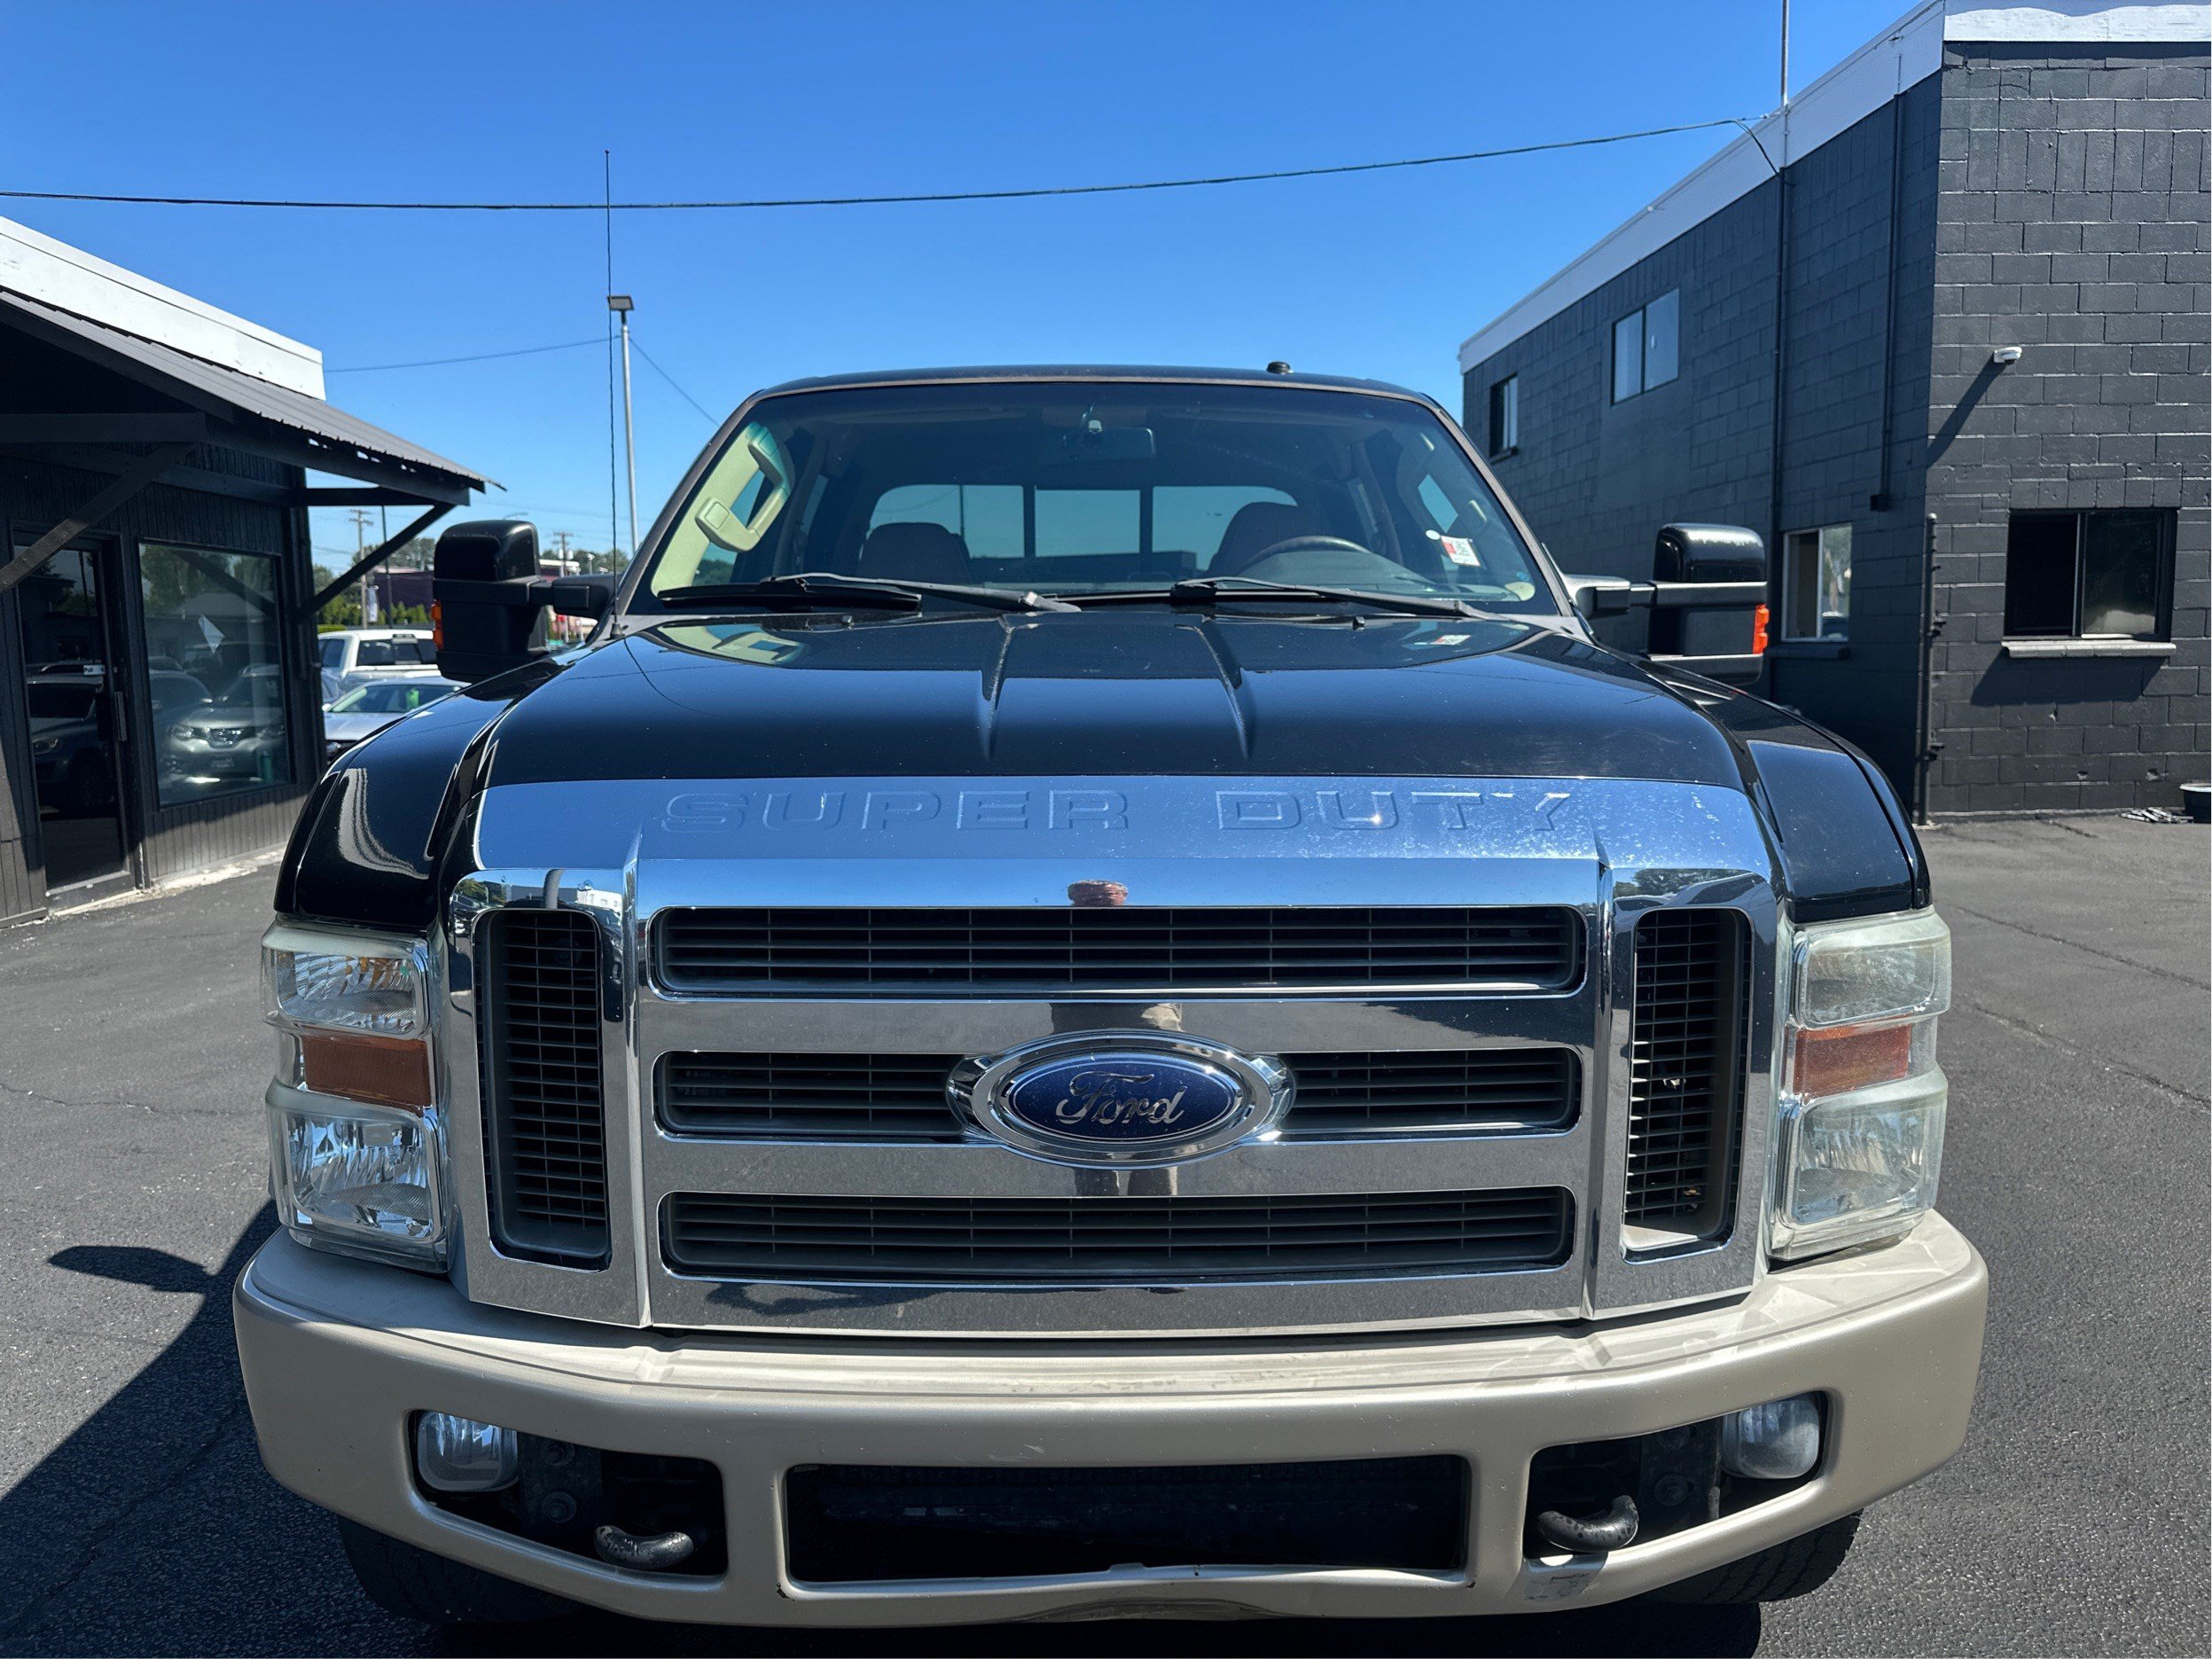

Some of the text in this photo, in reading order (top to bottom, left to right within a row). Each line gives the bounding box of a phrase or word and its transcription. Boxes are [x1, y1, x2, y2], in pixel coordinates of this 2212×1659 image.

[660, 790, 1572, 833] SUPER DUTY
[1055, 1071, 1188, 1124] Ford
